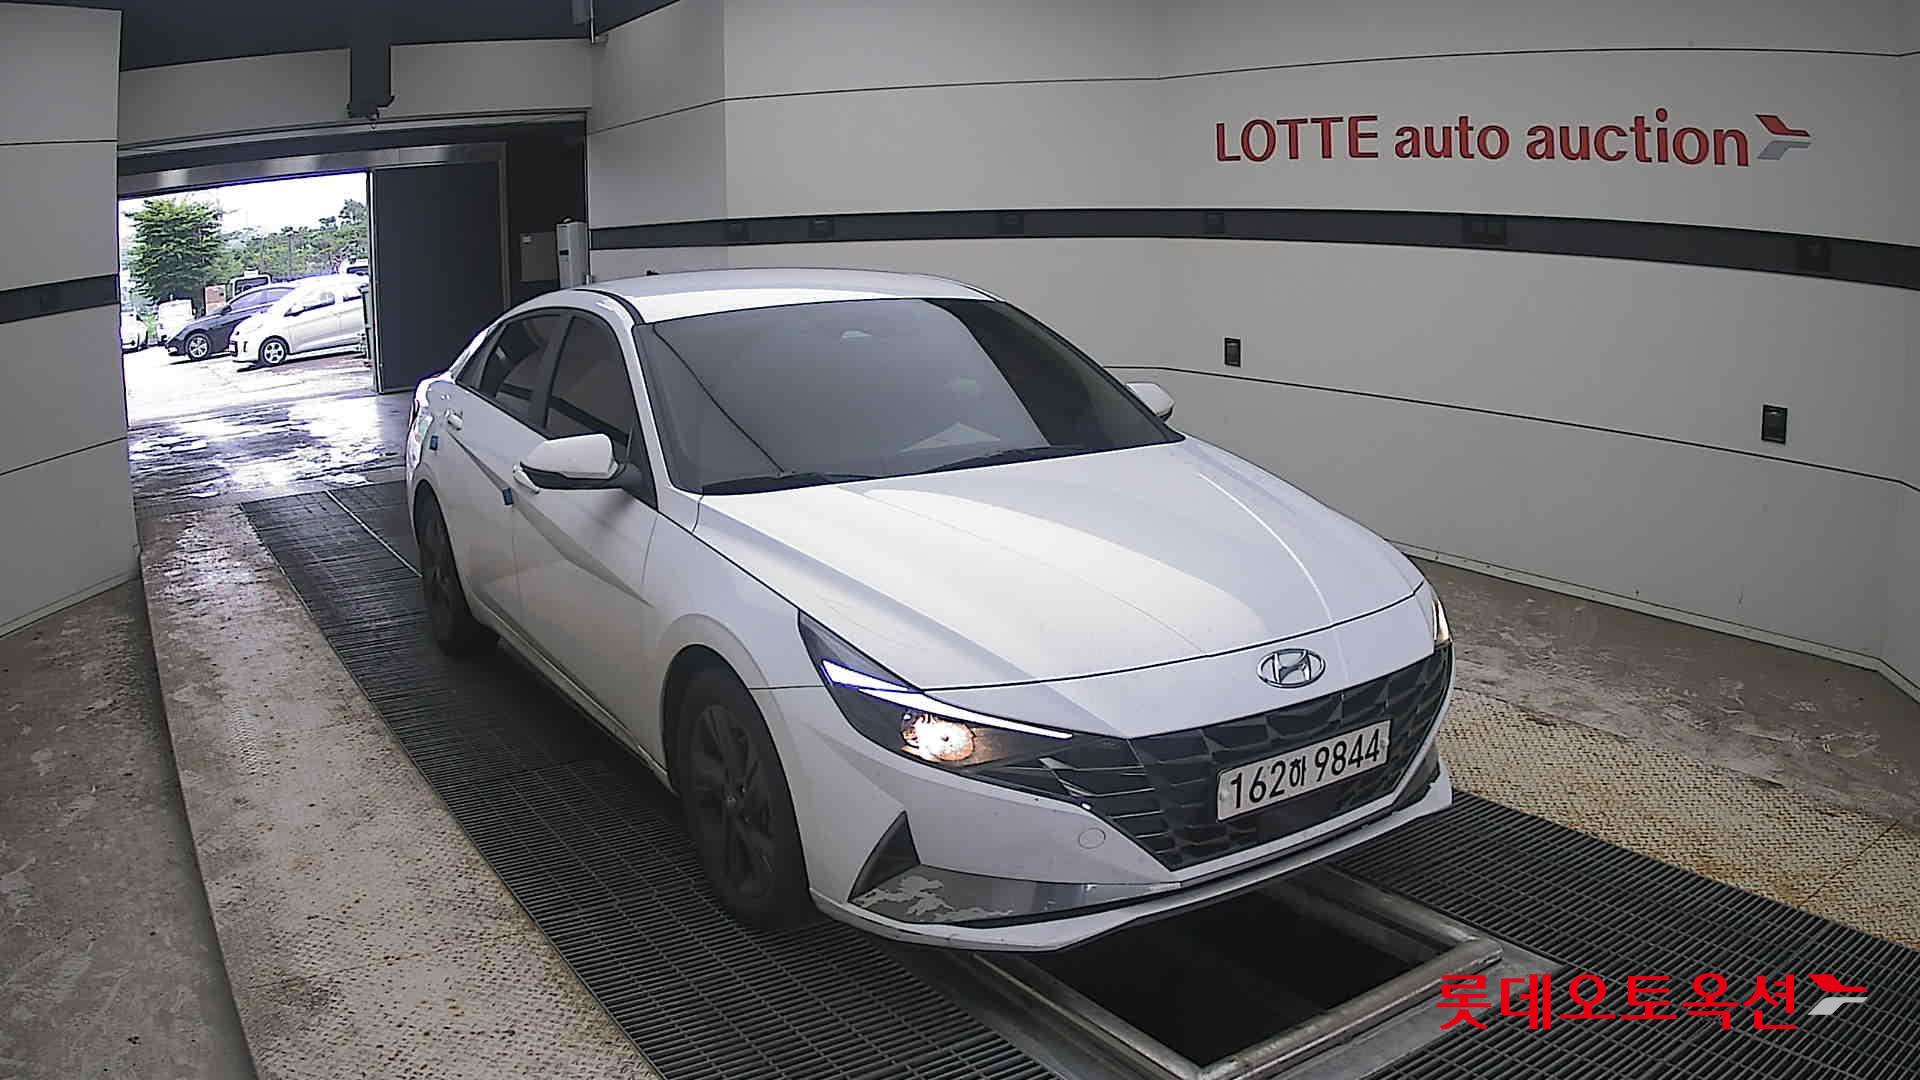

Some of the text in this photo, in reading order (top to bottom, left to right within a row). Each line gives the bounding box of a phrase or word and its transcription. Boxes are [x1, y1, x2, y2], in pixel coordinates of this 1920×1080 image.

[1215, 107, 1750, 167] LOTTE auto auction
[1314, 728, 1380, 783] 9844
